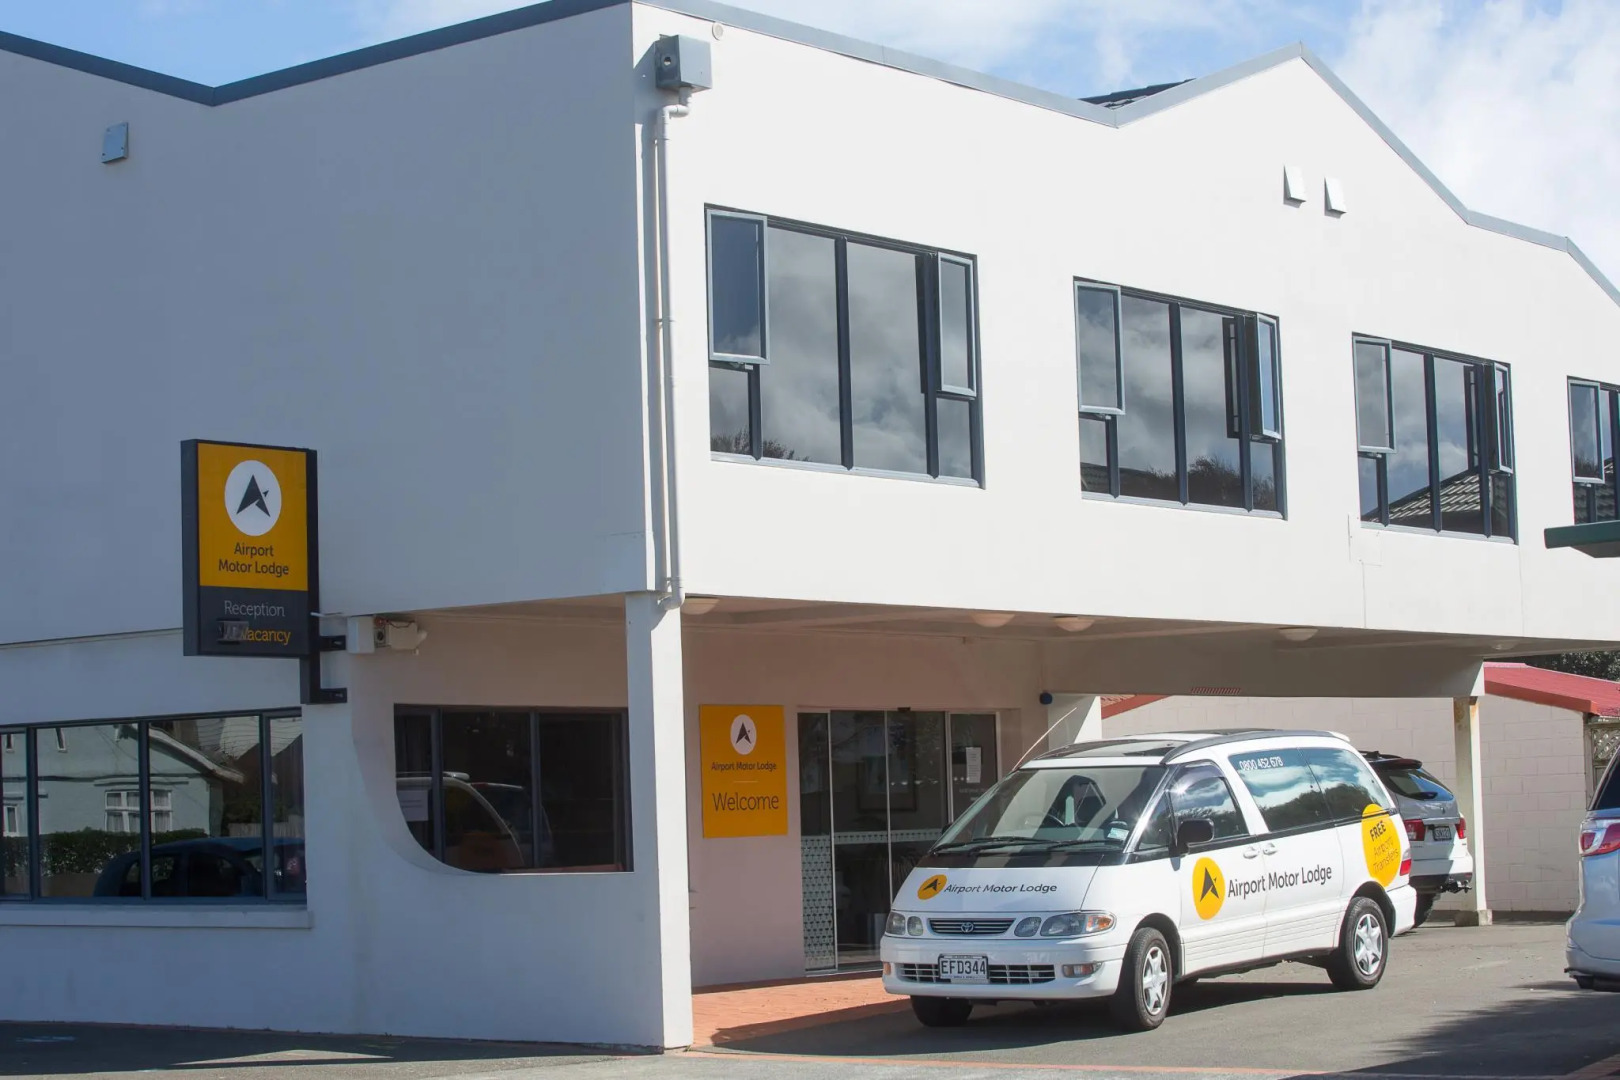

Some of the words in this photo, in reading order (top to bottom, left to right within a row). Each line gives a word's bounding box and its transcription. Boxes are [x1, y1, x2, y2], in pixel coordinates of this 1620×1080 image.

[233, 542, 275, 559] Airport
[218, 559, 252, 573] Motor
[255, 561, 290, 578] Lodge
[224, 600, 286, 619] Reception
[711, 761, 735, 773] Airport
[736, 761, 756, 771] Motor
[757, 760, 777, 772] Lodge
[1239, 759, 1258, 771] 0800
[1257, 757, 1271, 769] 452
[1270, 756, 1284, 768] 678
[712, 792, 779, 812] Welcome
[1369, 820, 1387, 842] FREE
[944, 884, 981, 895] Airport
[982, 884, 1018, 893] Motor
[1020, 883, 1057, 894] Lodge
[1228, 875, 1266, 900] Airport
[1268, 871, 1300, 891] Motor
[1301, 864, 1332, 885] Lodge
[941, 960, 986, 975] EFD344
